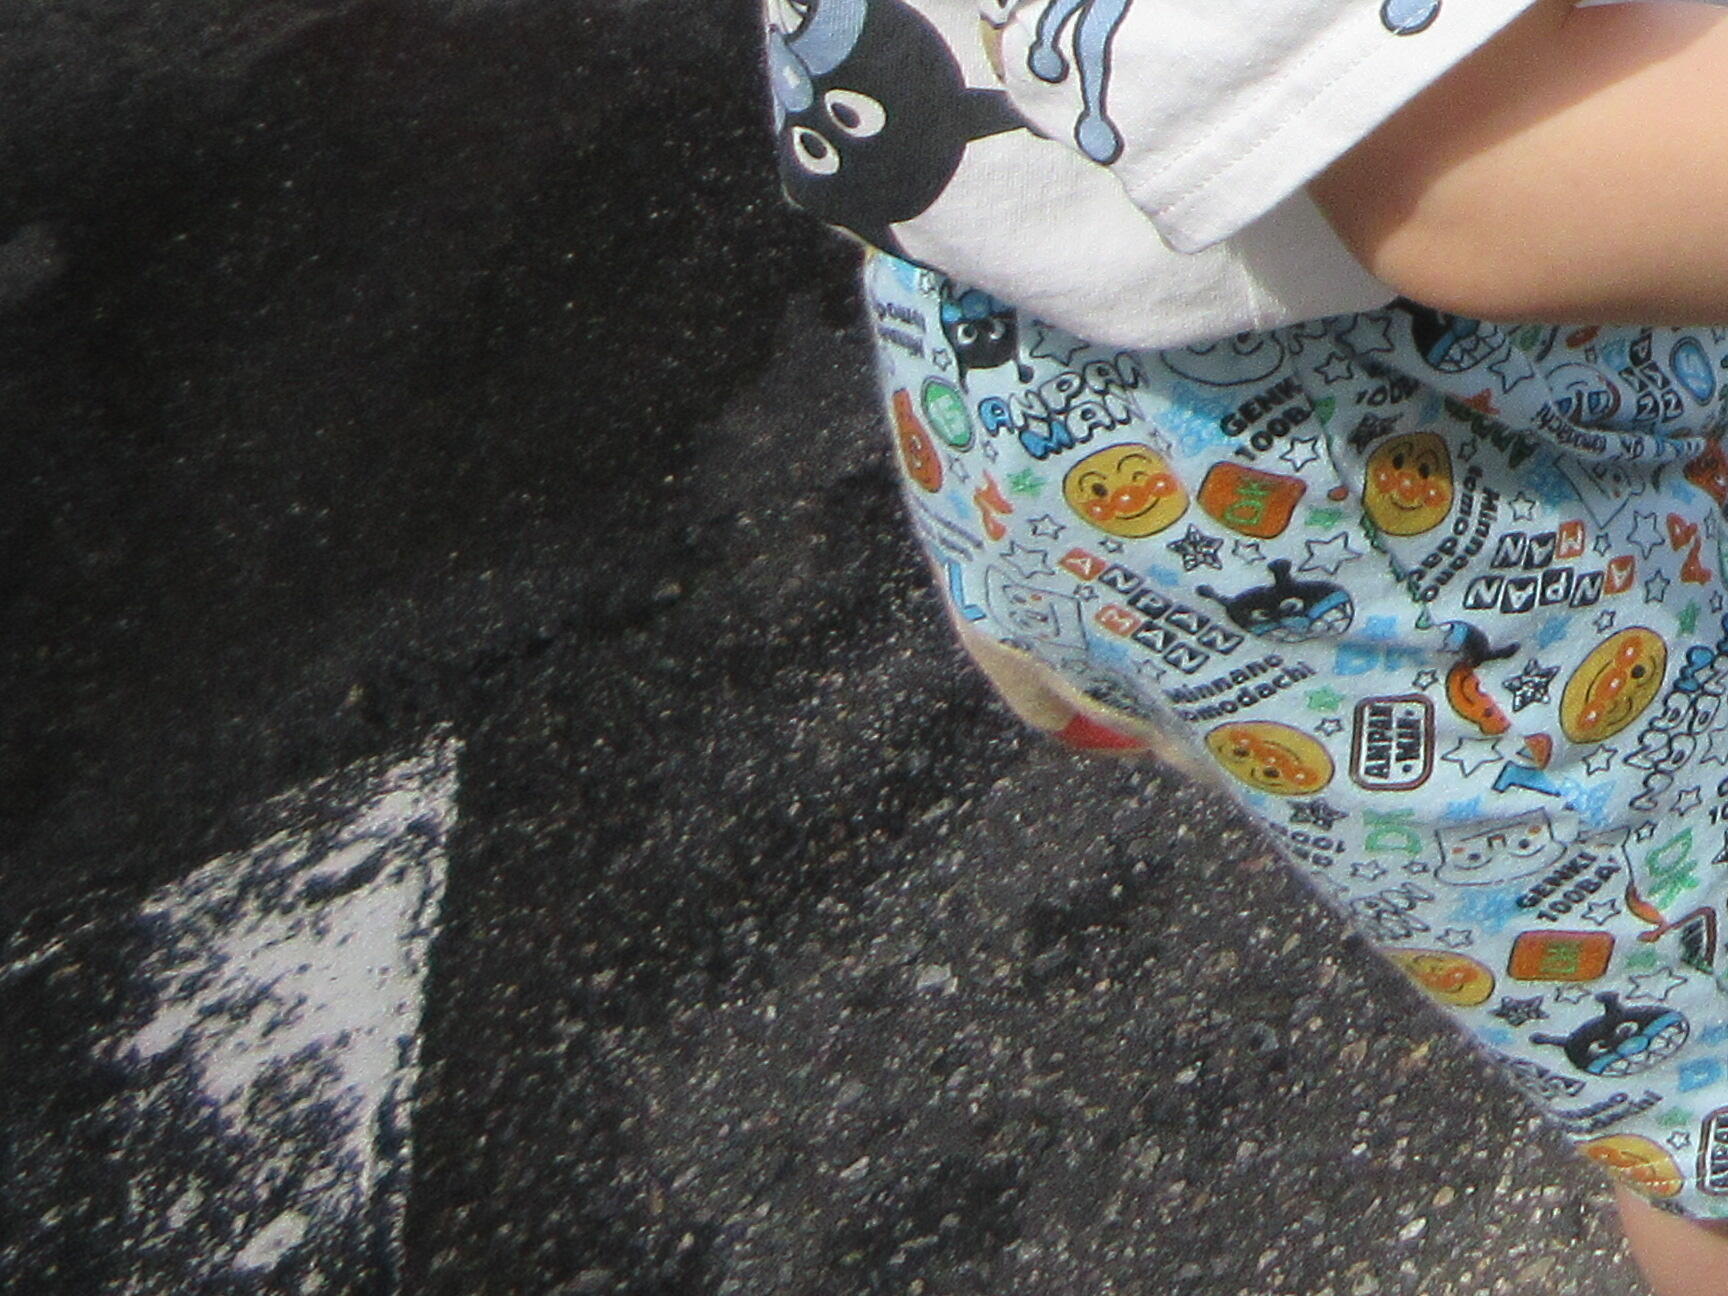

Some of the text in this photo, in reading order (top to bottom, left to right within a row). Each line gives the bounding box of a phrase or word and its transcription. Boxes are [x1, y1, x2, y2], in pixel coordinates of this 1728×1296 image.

[978, 351, 1147, 438] ANPAN
[1019, 393, 1144, 460] MAN
[1220, 372, 1306, 438] GENK
[1235, 406, 1313, 461] 100B
[1490, 519, 1585, 569] MAN
[1060, 547, 1244, 655] ANPAN
[1463, 555, 1635, 614] ANPAN
[1095, 604, 1210, 674] MAN
[1178, 661, 1317, 724] omodachi
[1364, 705, 1394, 780] ANPAN
[1516, 851, 1597, 908] GENKI
